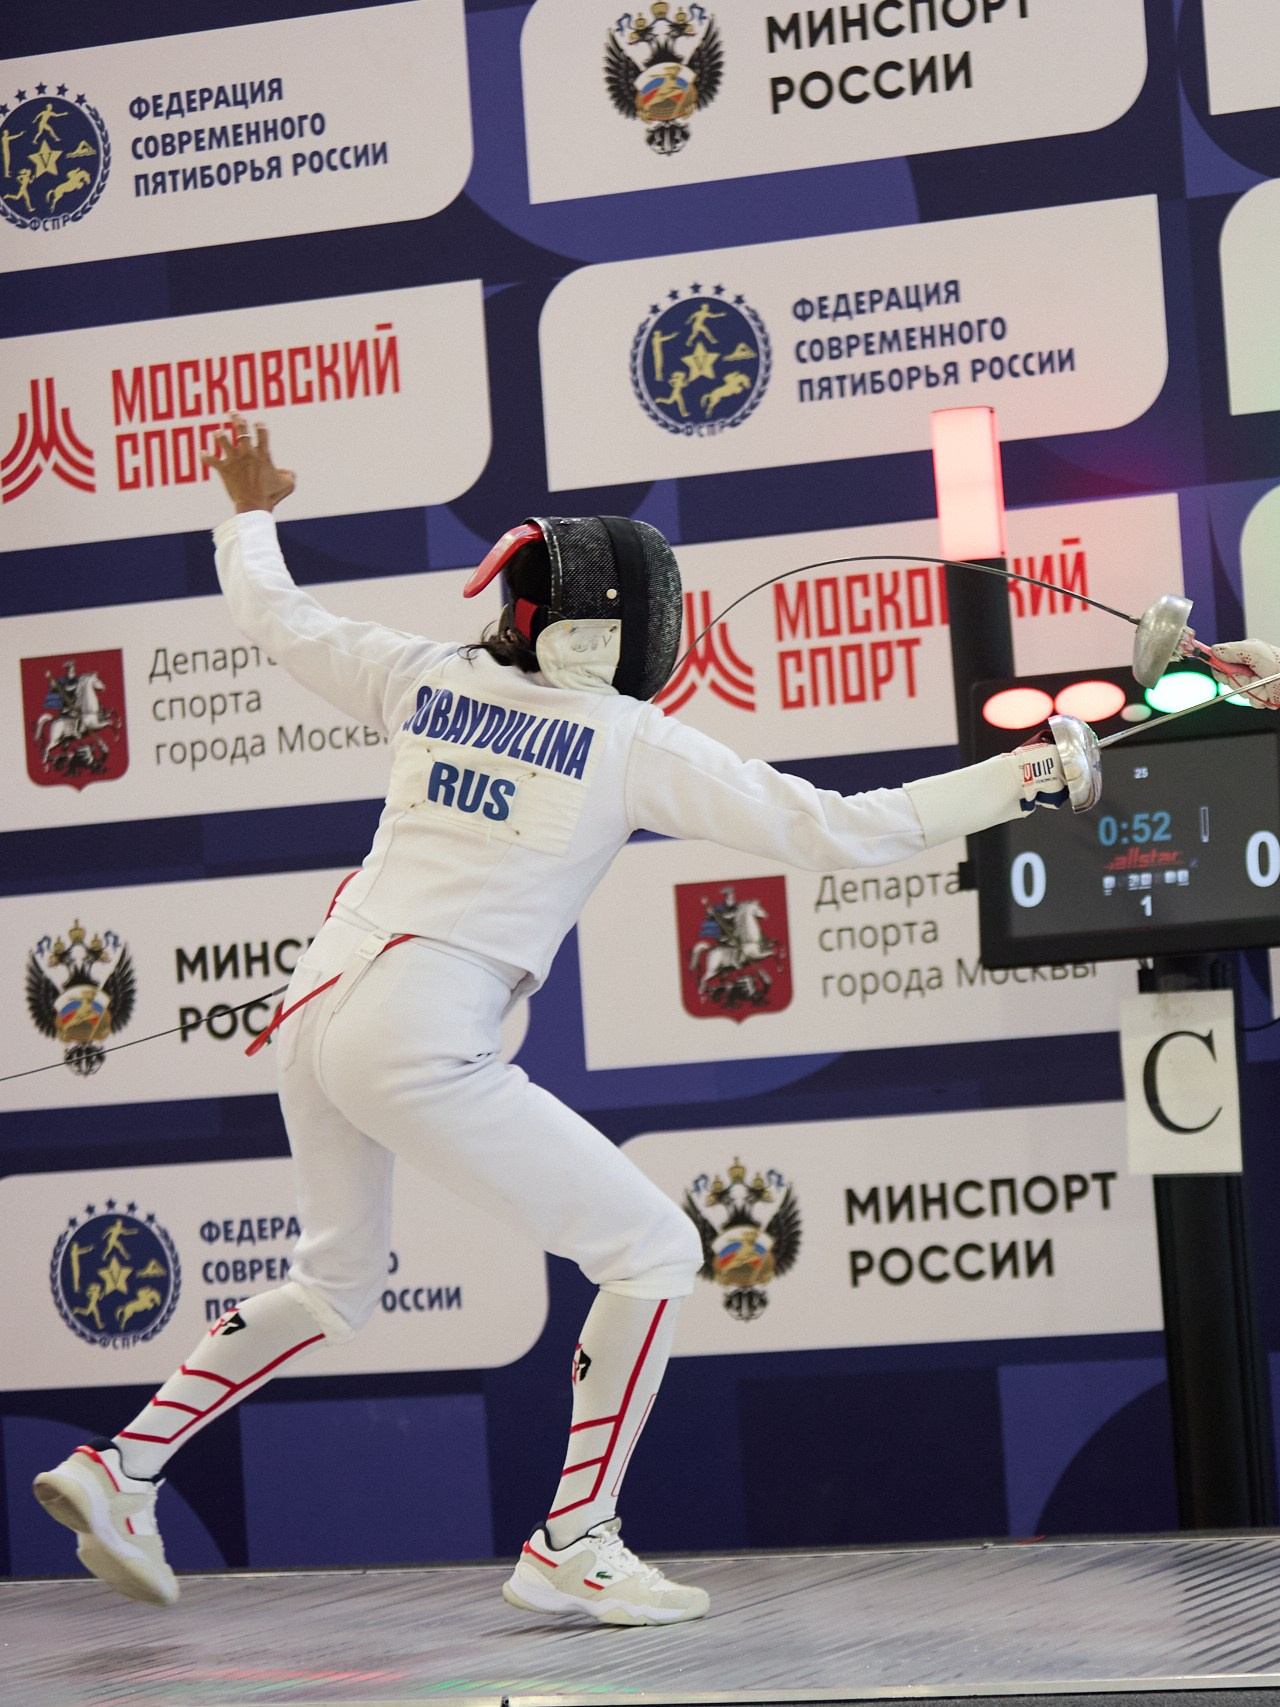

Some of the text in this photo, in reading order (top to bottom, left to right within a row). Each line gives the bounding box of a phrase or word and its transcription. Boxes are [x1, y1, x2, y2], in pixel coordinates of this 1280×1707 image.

[129, 77, 283, 122] ФЕДЕРАЦИЯ
[769, 51, 973, 115] РОССИИ
[131, 112, 326, 160] СОВРЕМЕННОГО
[134, 141, 389, 198] ПЯТИБОРЬЯ РОССИИ
[30, 214, 70, 231] ФСПР
[792, 279, 960, 323] ФЕДЕРАЦИЯ
[795, 316, 1007, 364] СОВРЕМЕННОГО
[111, 322, 400, 427] МОСКОВСКИЙ
[798, 347, 1076, 403] ПЯТИБОРЬЯ РОССИИ
[149, 645, 278, 684] Департ
[777, 637, 922, 711] СПОРТ
[152, 694, 262, 725] спорта
[155, 723, 388, 771] города Москв
[427, 761, 517, 822] RUS
[1133, 767, 1149, 780] 25
[1098, 811, 1172, 846] 0:52
[814, 868, 960, 913] Департа
[1010, 852, 1047, 908] 0
[1140, 894, 1153, 917] 1
[175, 936, 315, 985] МИНС
[818, 919, 939, 957] спорта
[821, 961, 944, 1003] города
[179, 1000, 282, 1043] РОС
[1141, 1028, 1223, 1136] C
[844, 1171, 1118, 1227] МИНСПОРТ
[199, 1216, 302, 1246] ФЕДЕРА
[848, 1238, 1056, 1288] РОССИИ
[381, 1285, 463, 1314] ОССИИ
